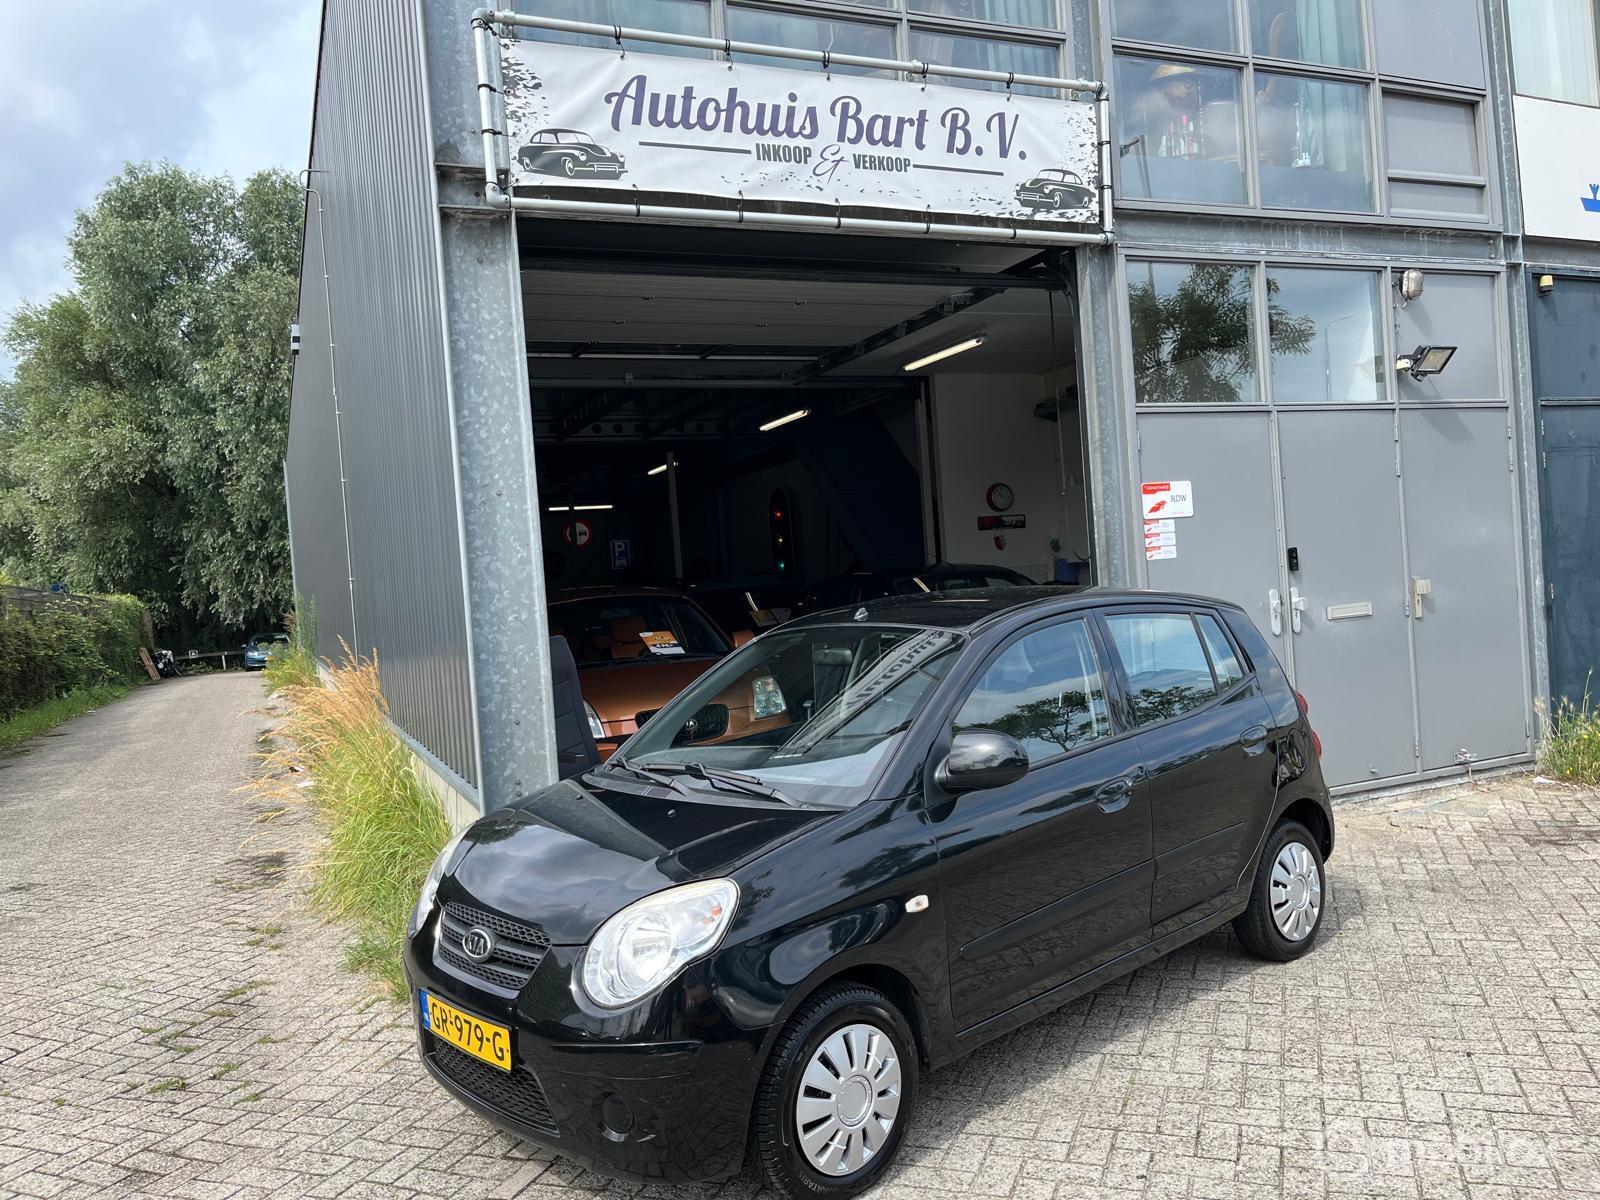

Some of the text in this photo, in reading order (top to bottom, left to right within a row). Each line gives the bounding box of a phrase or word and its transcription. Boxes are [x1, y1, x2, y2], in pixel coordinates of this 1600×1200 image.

[604, 74, 1027, 160] Autohuis Bart B.V.
[755, 143, 812, 165] INKOOP
[852, 153, 911, 173] VERKOOP
[1170, 494, 1187, 503] RDW
[615, 541, 625, 558] P
